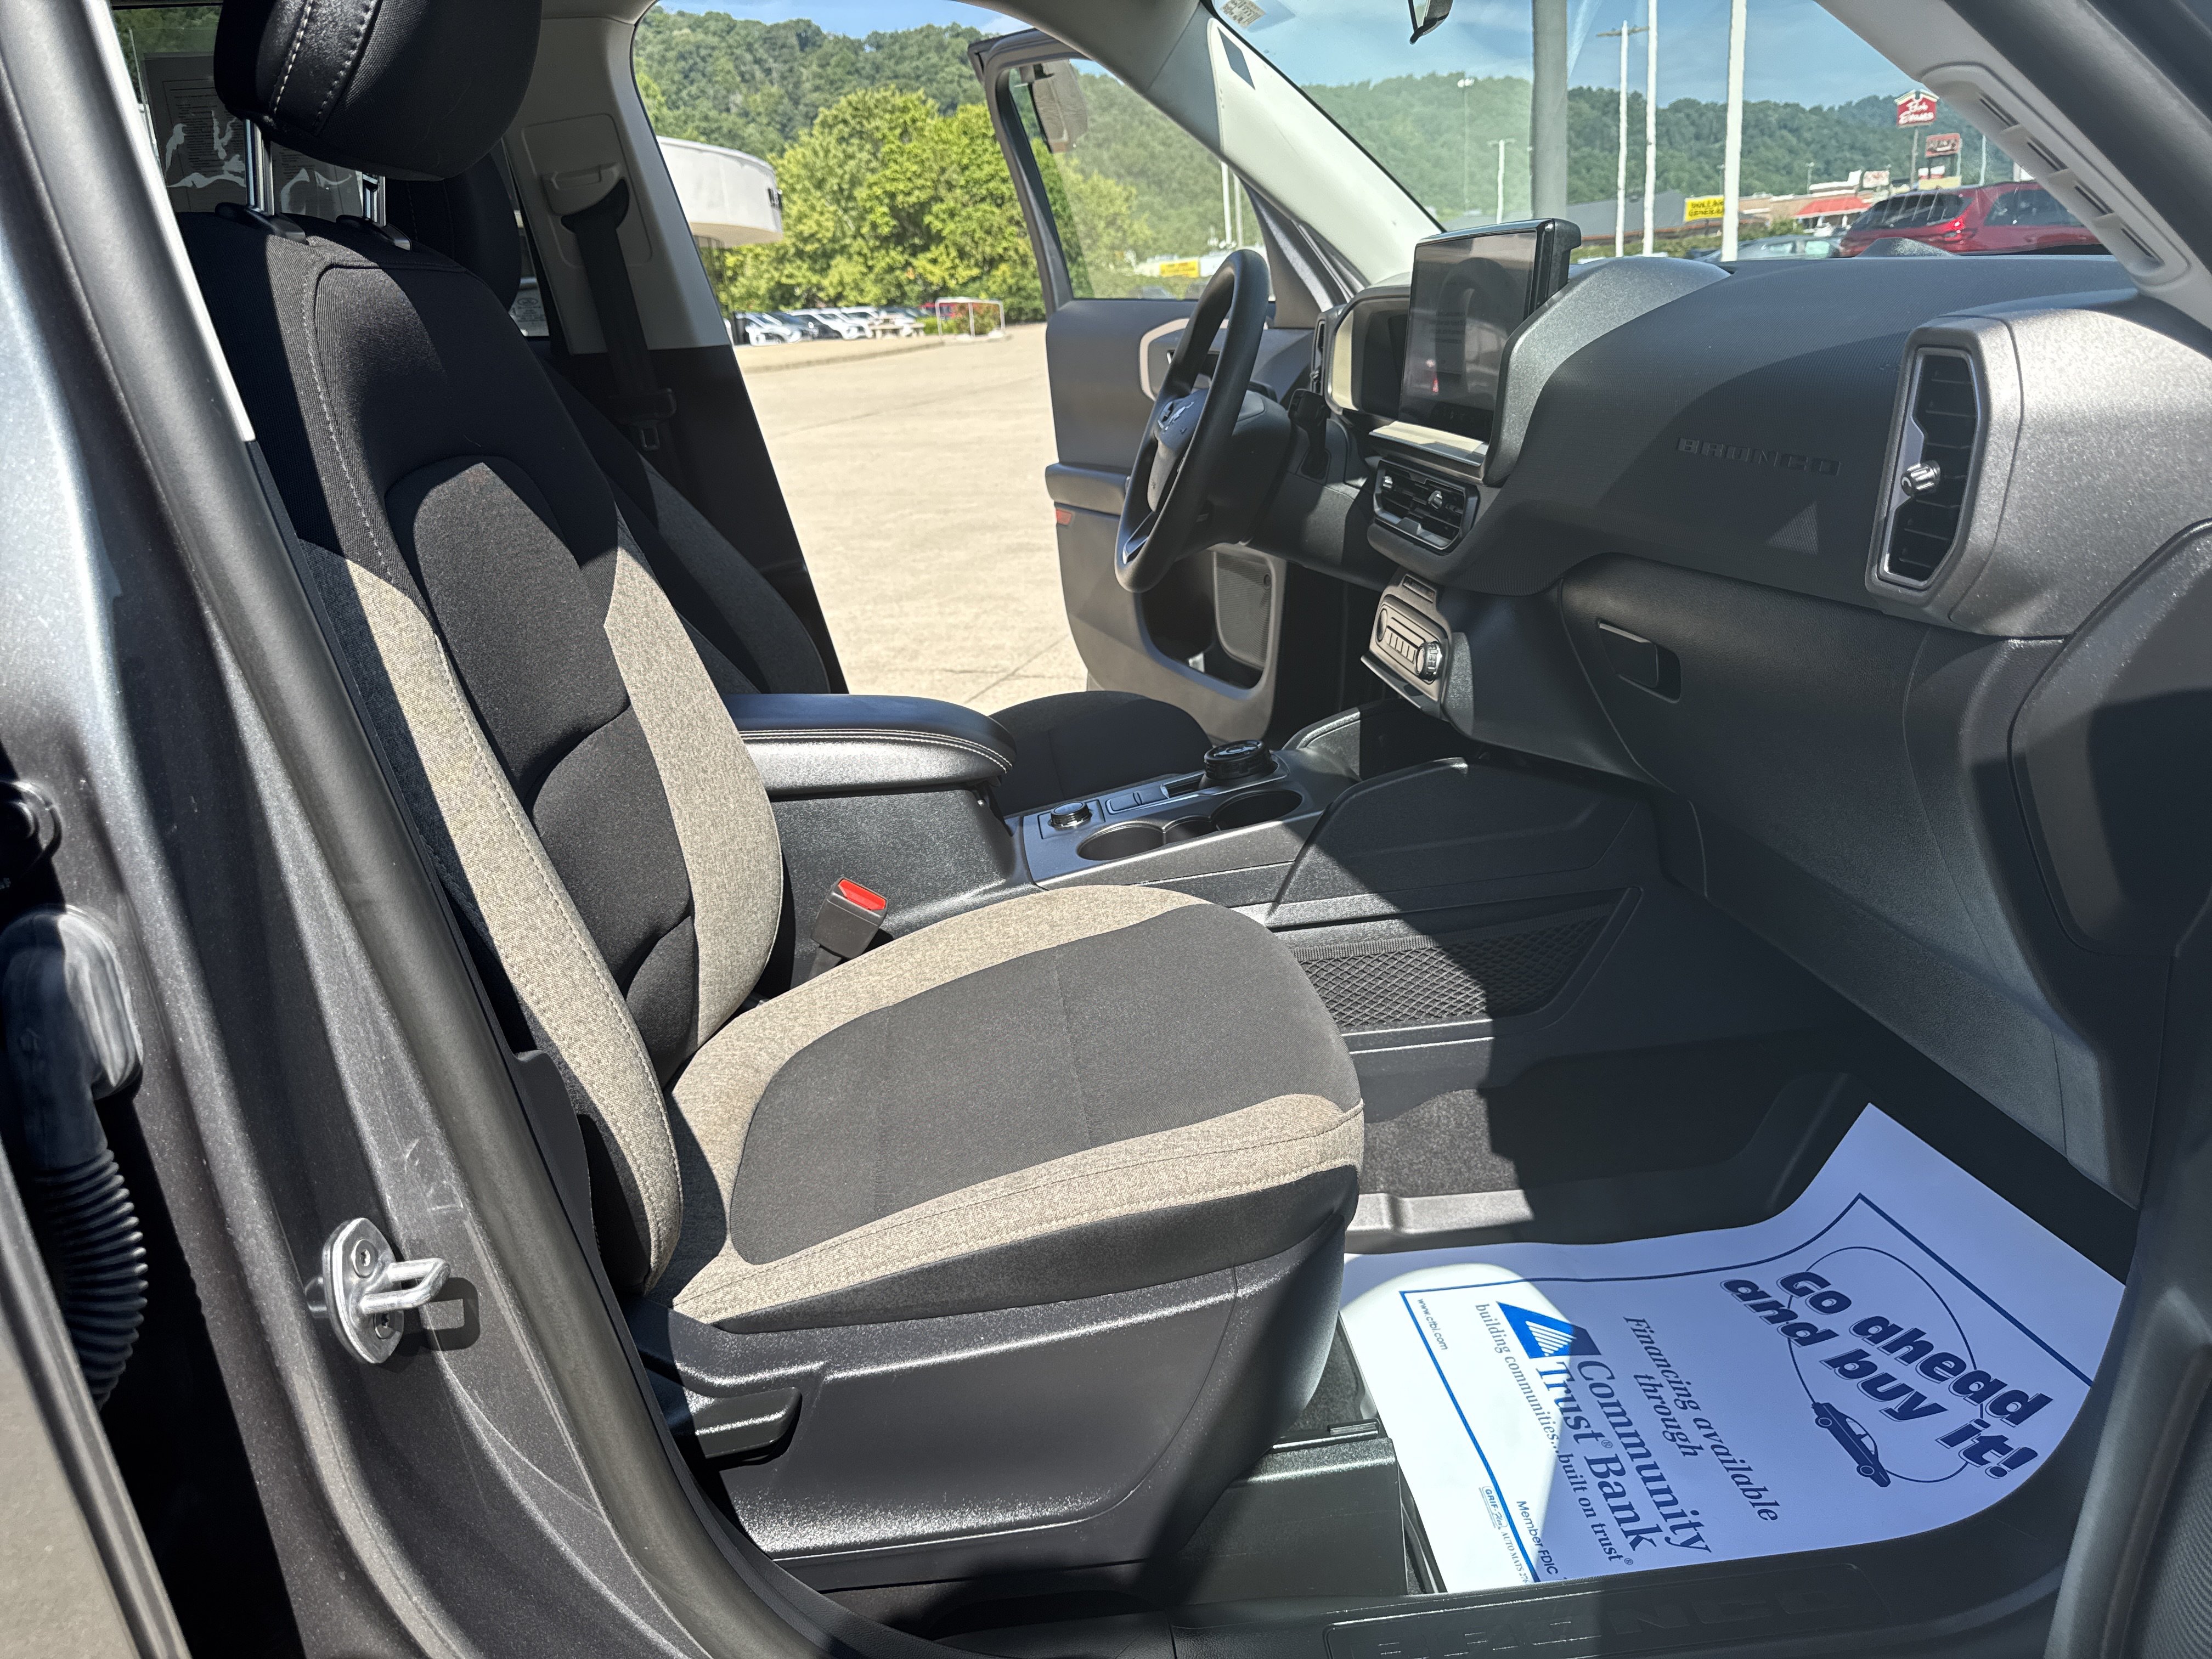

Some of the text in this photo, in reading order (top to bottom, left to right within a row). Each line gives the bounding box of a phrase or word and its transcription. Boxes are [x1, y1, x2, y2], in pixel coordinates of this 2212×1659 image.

[1677, 438, 1842, 476] BRONCO
[1475, 1303, 1511, 1353] building
[1578, 1497, 1596, 1519] on
[1720, 1279, 2038, 1479] and buy it!
[1776, 1271, 2053, 1427] Go ahead
[1577, 1361, 1712, 1553] Community
[1623, 1317, 1780, 1521] Financing available
[1633, 1374, 1704, 1457] through
[1501, 1532, 1515, 1551] AUTO
[1510, 1552, 1525, 1571] MATS
[1516, 1500, 1559, 1576] Member FDIC
[1583, 1453, 1663, 1551] Bank
